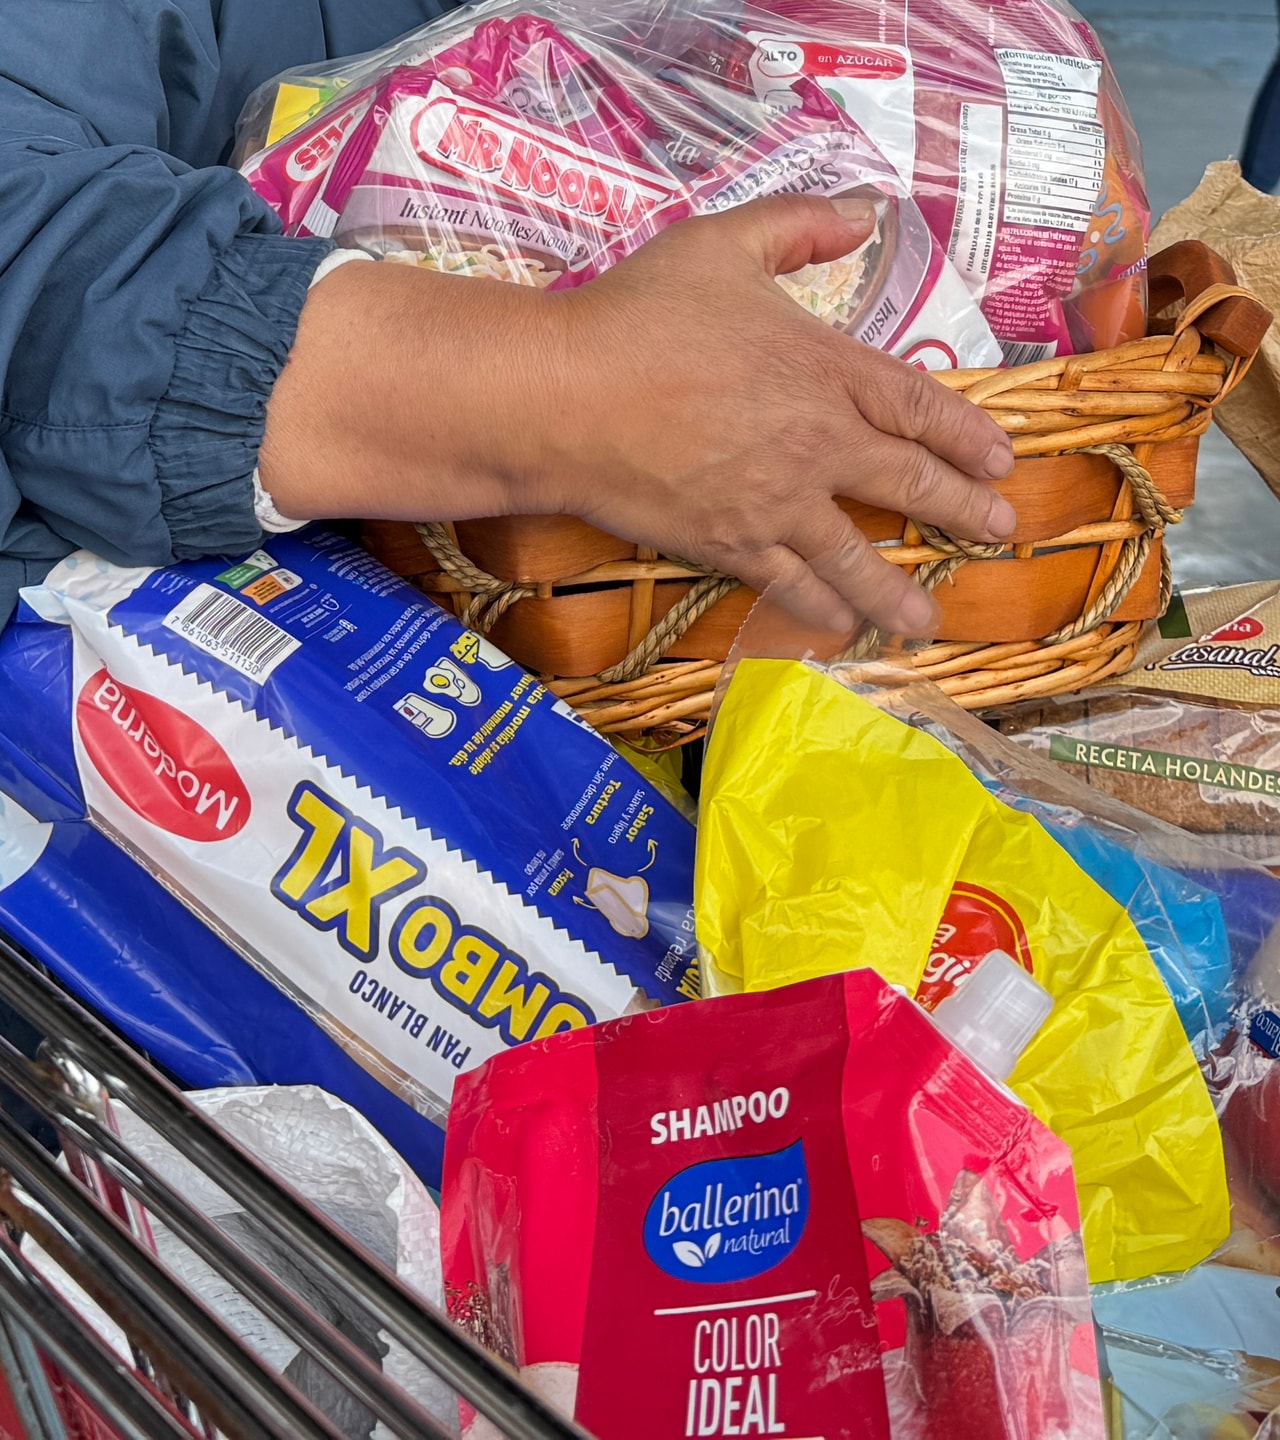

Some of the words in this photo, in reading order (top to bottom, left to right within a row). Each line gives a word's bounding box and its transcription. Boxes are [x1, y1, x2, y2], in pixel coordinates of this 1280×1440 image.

[762, 50, 798, 63] ALTO
[818, 54, 833, 64] en
[436, 114, 504, 174] MR.
[399, 196, 470, 227] Instant
[181, 622, 220, 652] 861063
[220, 647, 259, 676] 511130
[496, 705, 531, 745] mordida
[92, 677, 239, 832] Moderna
[1075, 743, 1157, 774] RECETA
[584, 778, 622, 826] Textura
[624, 803, 656, 844] Sabor
[628, 788, 647, 814] suave
[607, 817, 625, 845] ligero
[273, 783, 424, 959] XL
[348, 969, 428, 1039] BLANCO
[430, 1030, 472, 1070] PAN
[649, 1086, 790, 1145] SHAMPOO
[658, 1181, 800, 1237] ballerina
[723, 1216, 791, 1255] natural
[693, 1312, 782, 1374] COLOR
[684, 1373, 786, 1437] IDEAL
